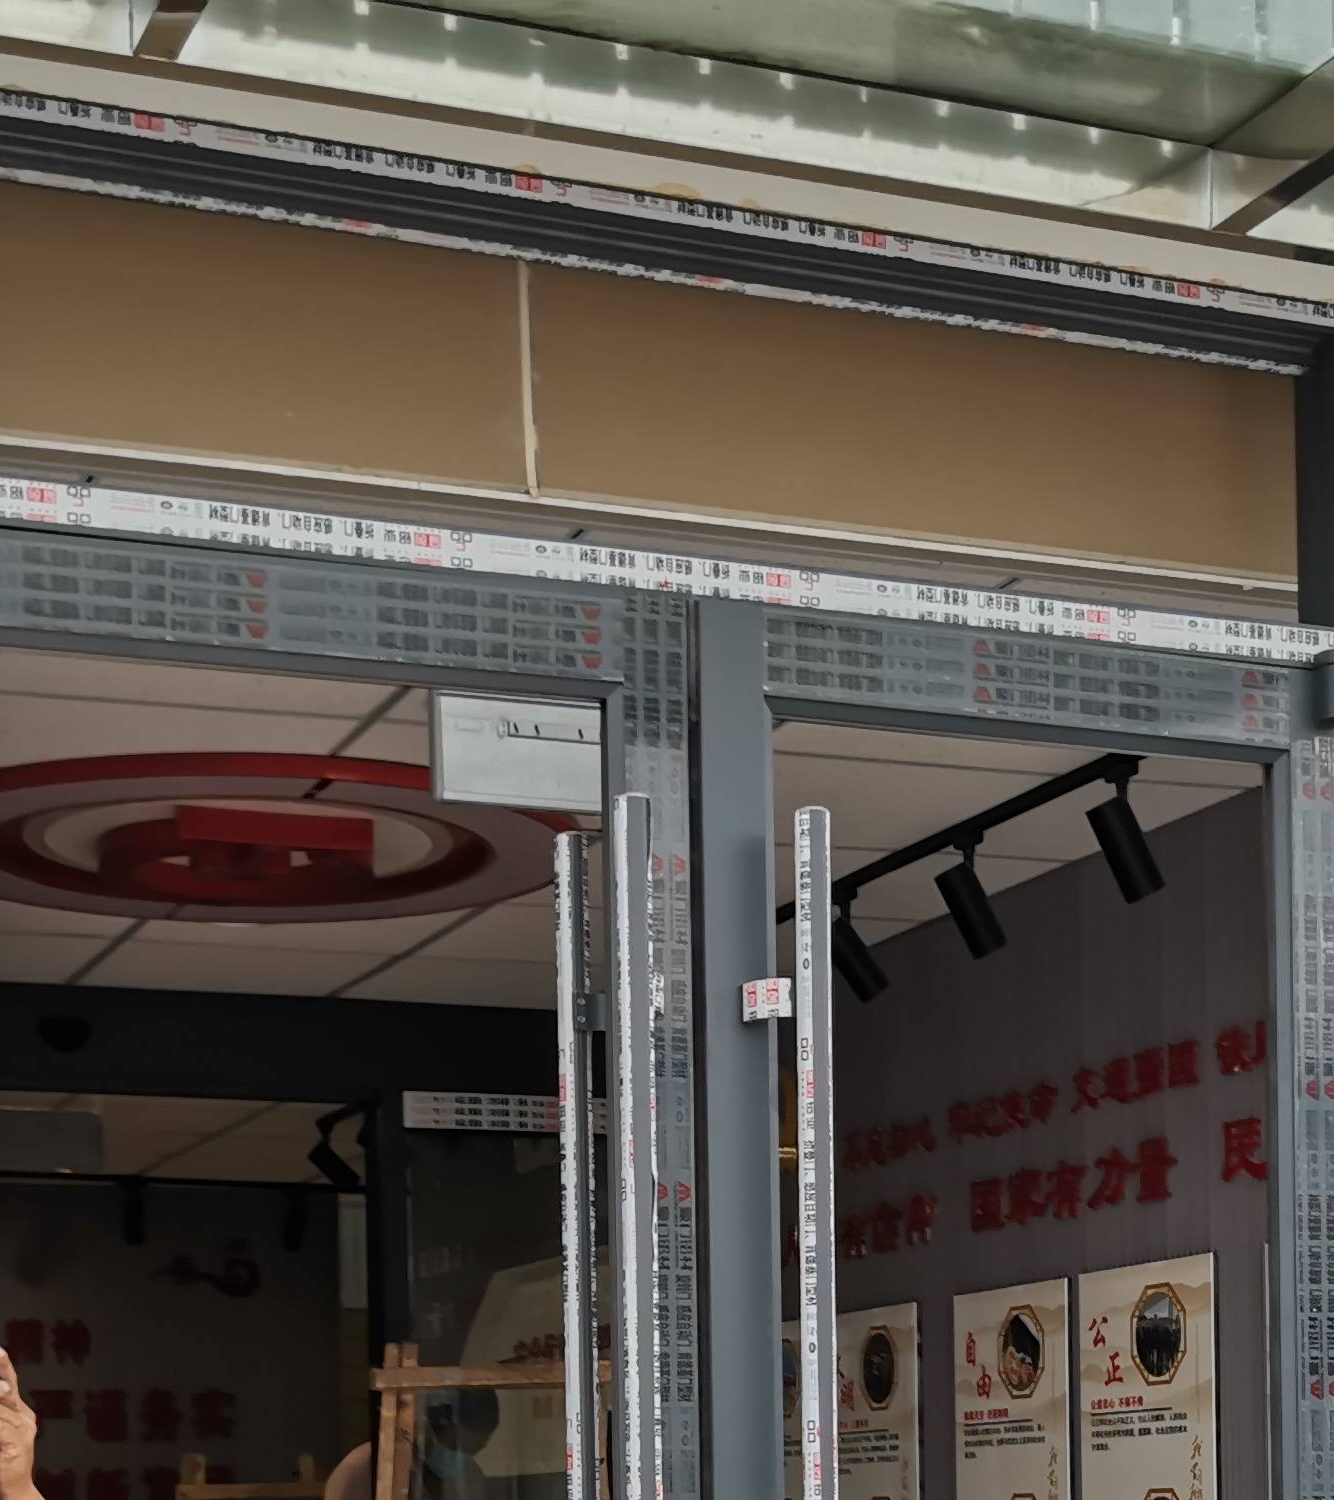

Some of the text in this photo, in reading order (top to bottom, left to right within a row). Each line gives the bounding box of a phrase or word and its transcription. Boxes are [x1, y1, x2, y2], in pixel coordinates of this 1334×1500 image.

[969, 1136, 1178, 1233] 国家有力量
[965, 1331, 992, 1399] 自由
[1088, 1315, 1123, 1386] 公正
